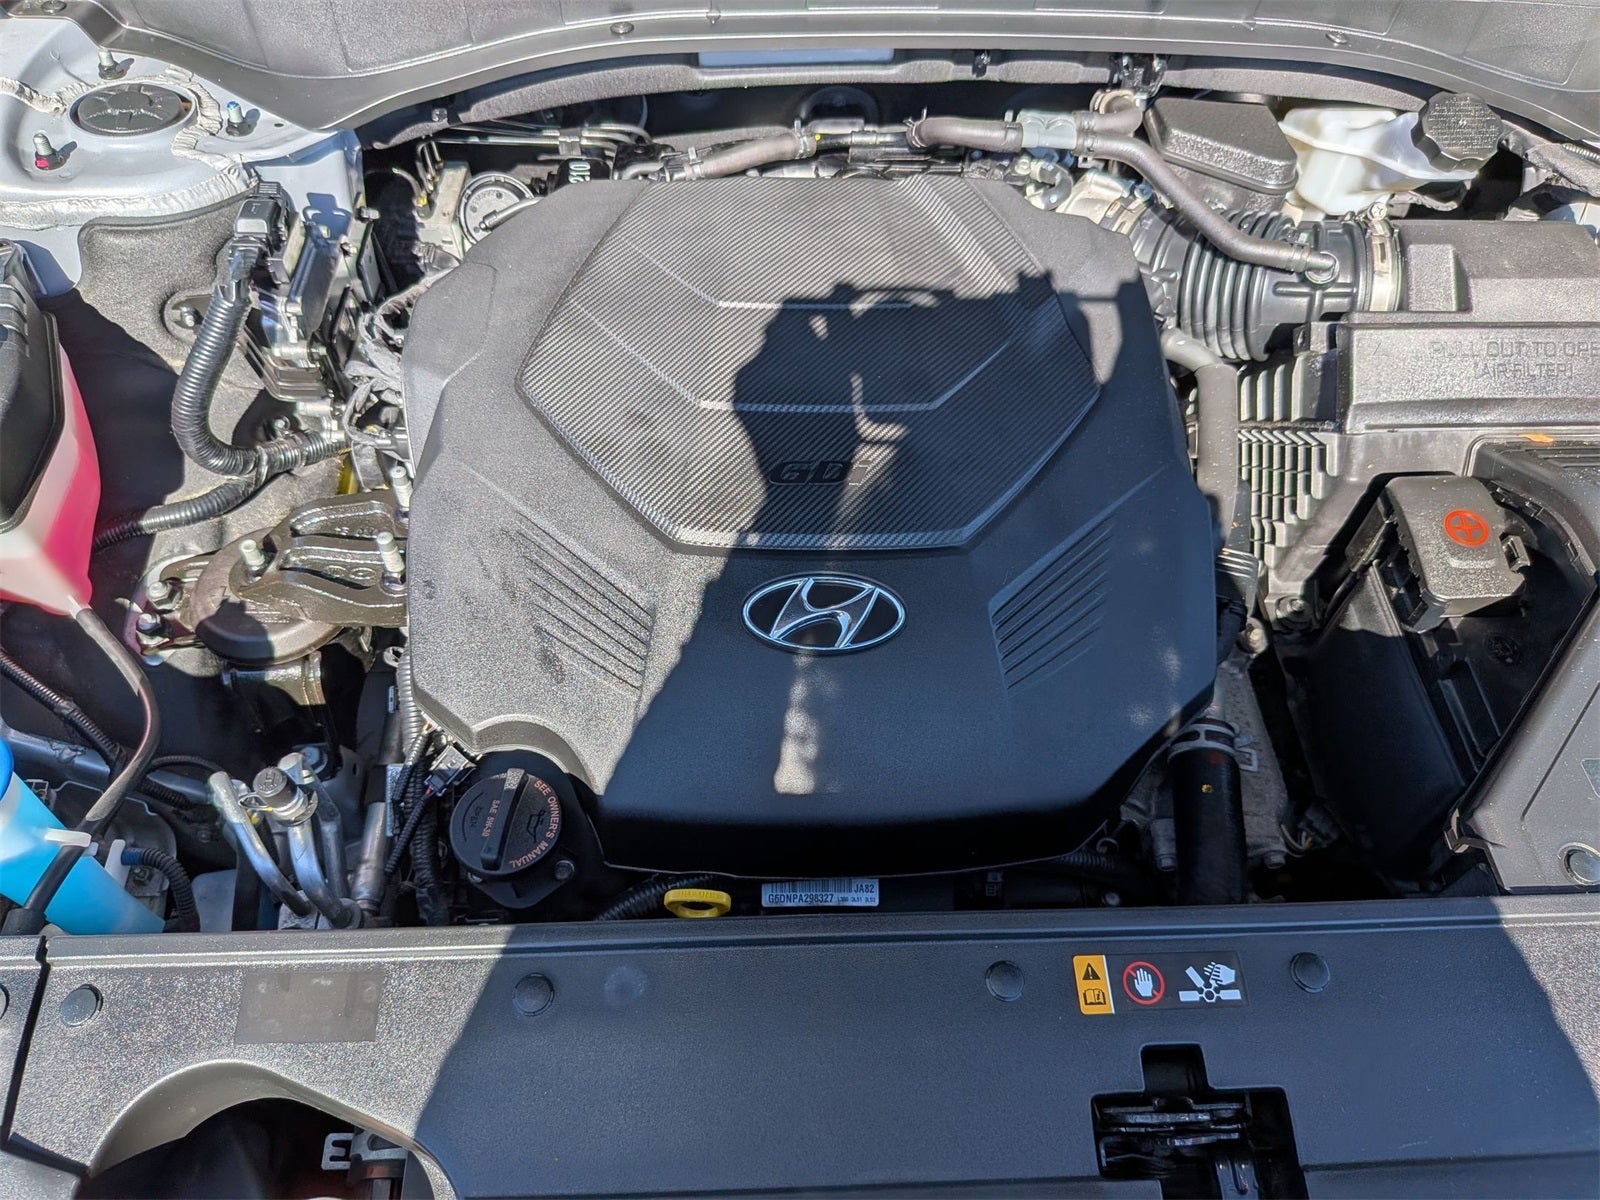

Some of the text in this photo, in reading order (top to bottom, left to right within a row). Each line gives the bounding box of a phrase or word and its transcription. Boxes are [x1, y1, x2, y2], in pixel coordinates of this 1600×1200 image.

[1486, 341, 1526, 357] OUT
[1531, 341, 1556, 357] TO
[490, 799, 500, 813] SAE
[509, 780, 559, 868] SEE OWNER'S MANUAL
[853, 884, 875, 893] JA82
